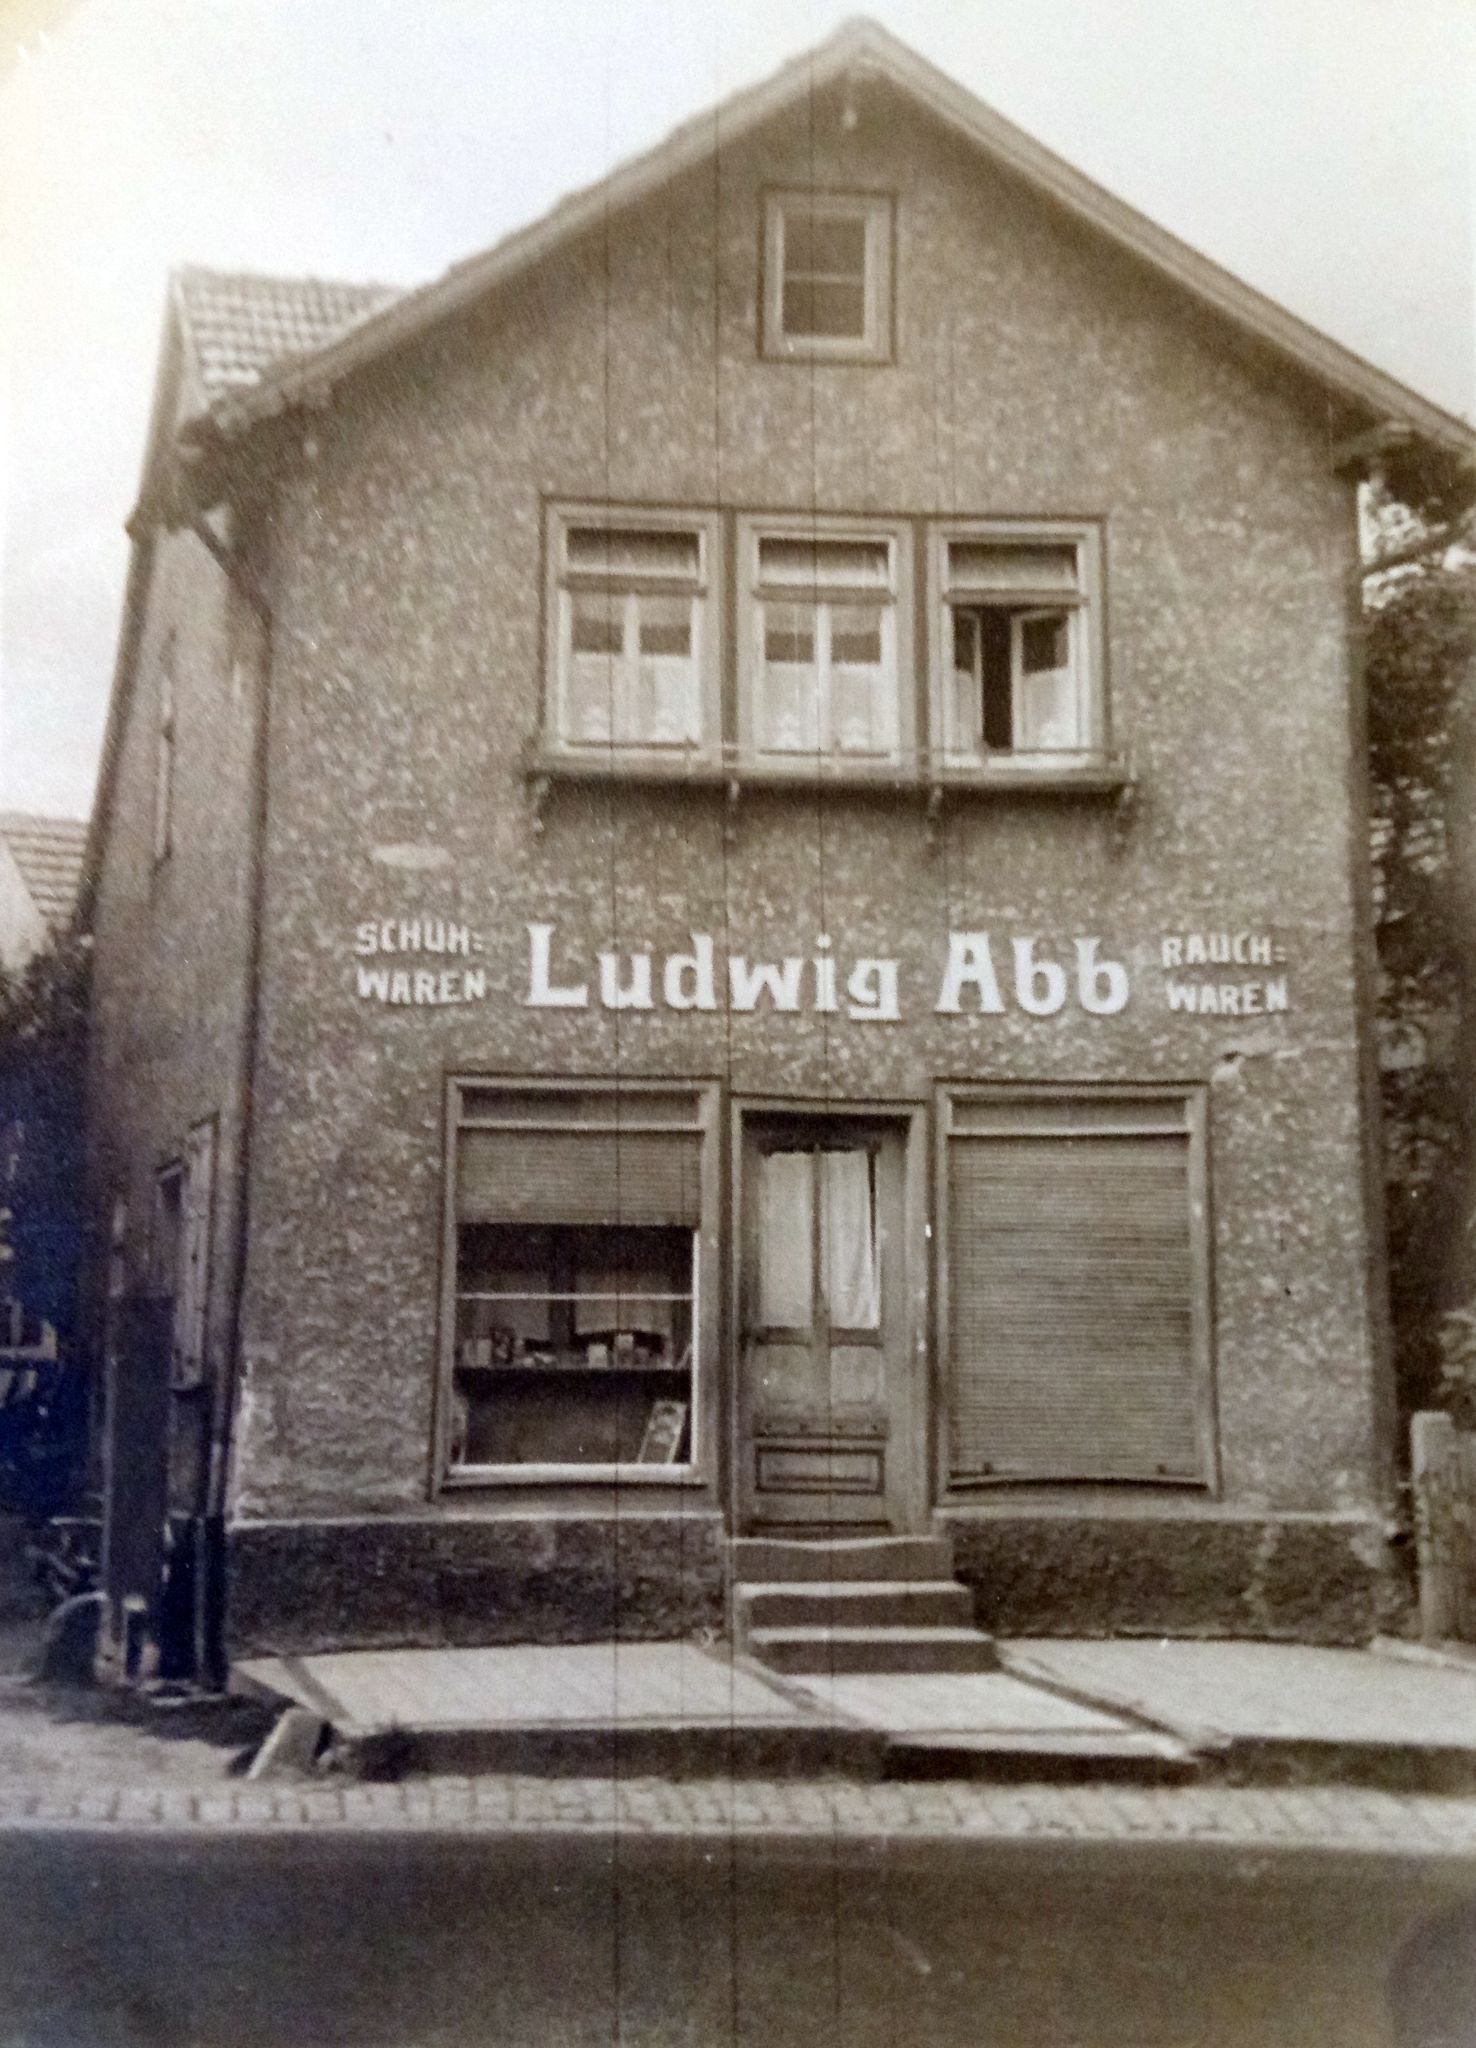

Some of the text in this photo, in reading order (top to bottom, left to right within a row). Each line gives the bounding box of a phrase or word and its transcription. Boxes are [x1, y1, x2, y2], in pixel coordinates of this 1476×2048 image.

[356, 965, 487, 1004] WAREN
[524, 923, 1130, 1021] Ludwig Abb
[1166, 975, 1289, 1015] WAREN
